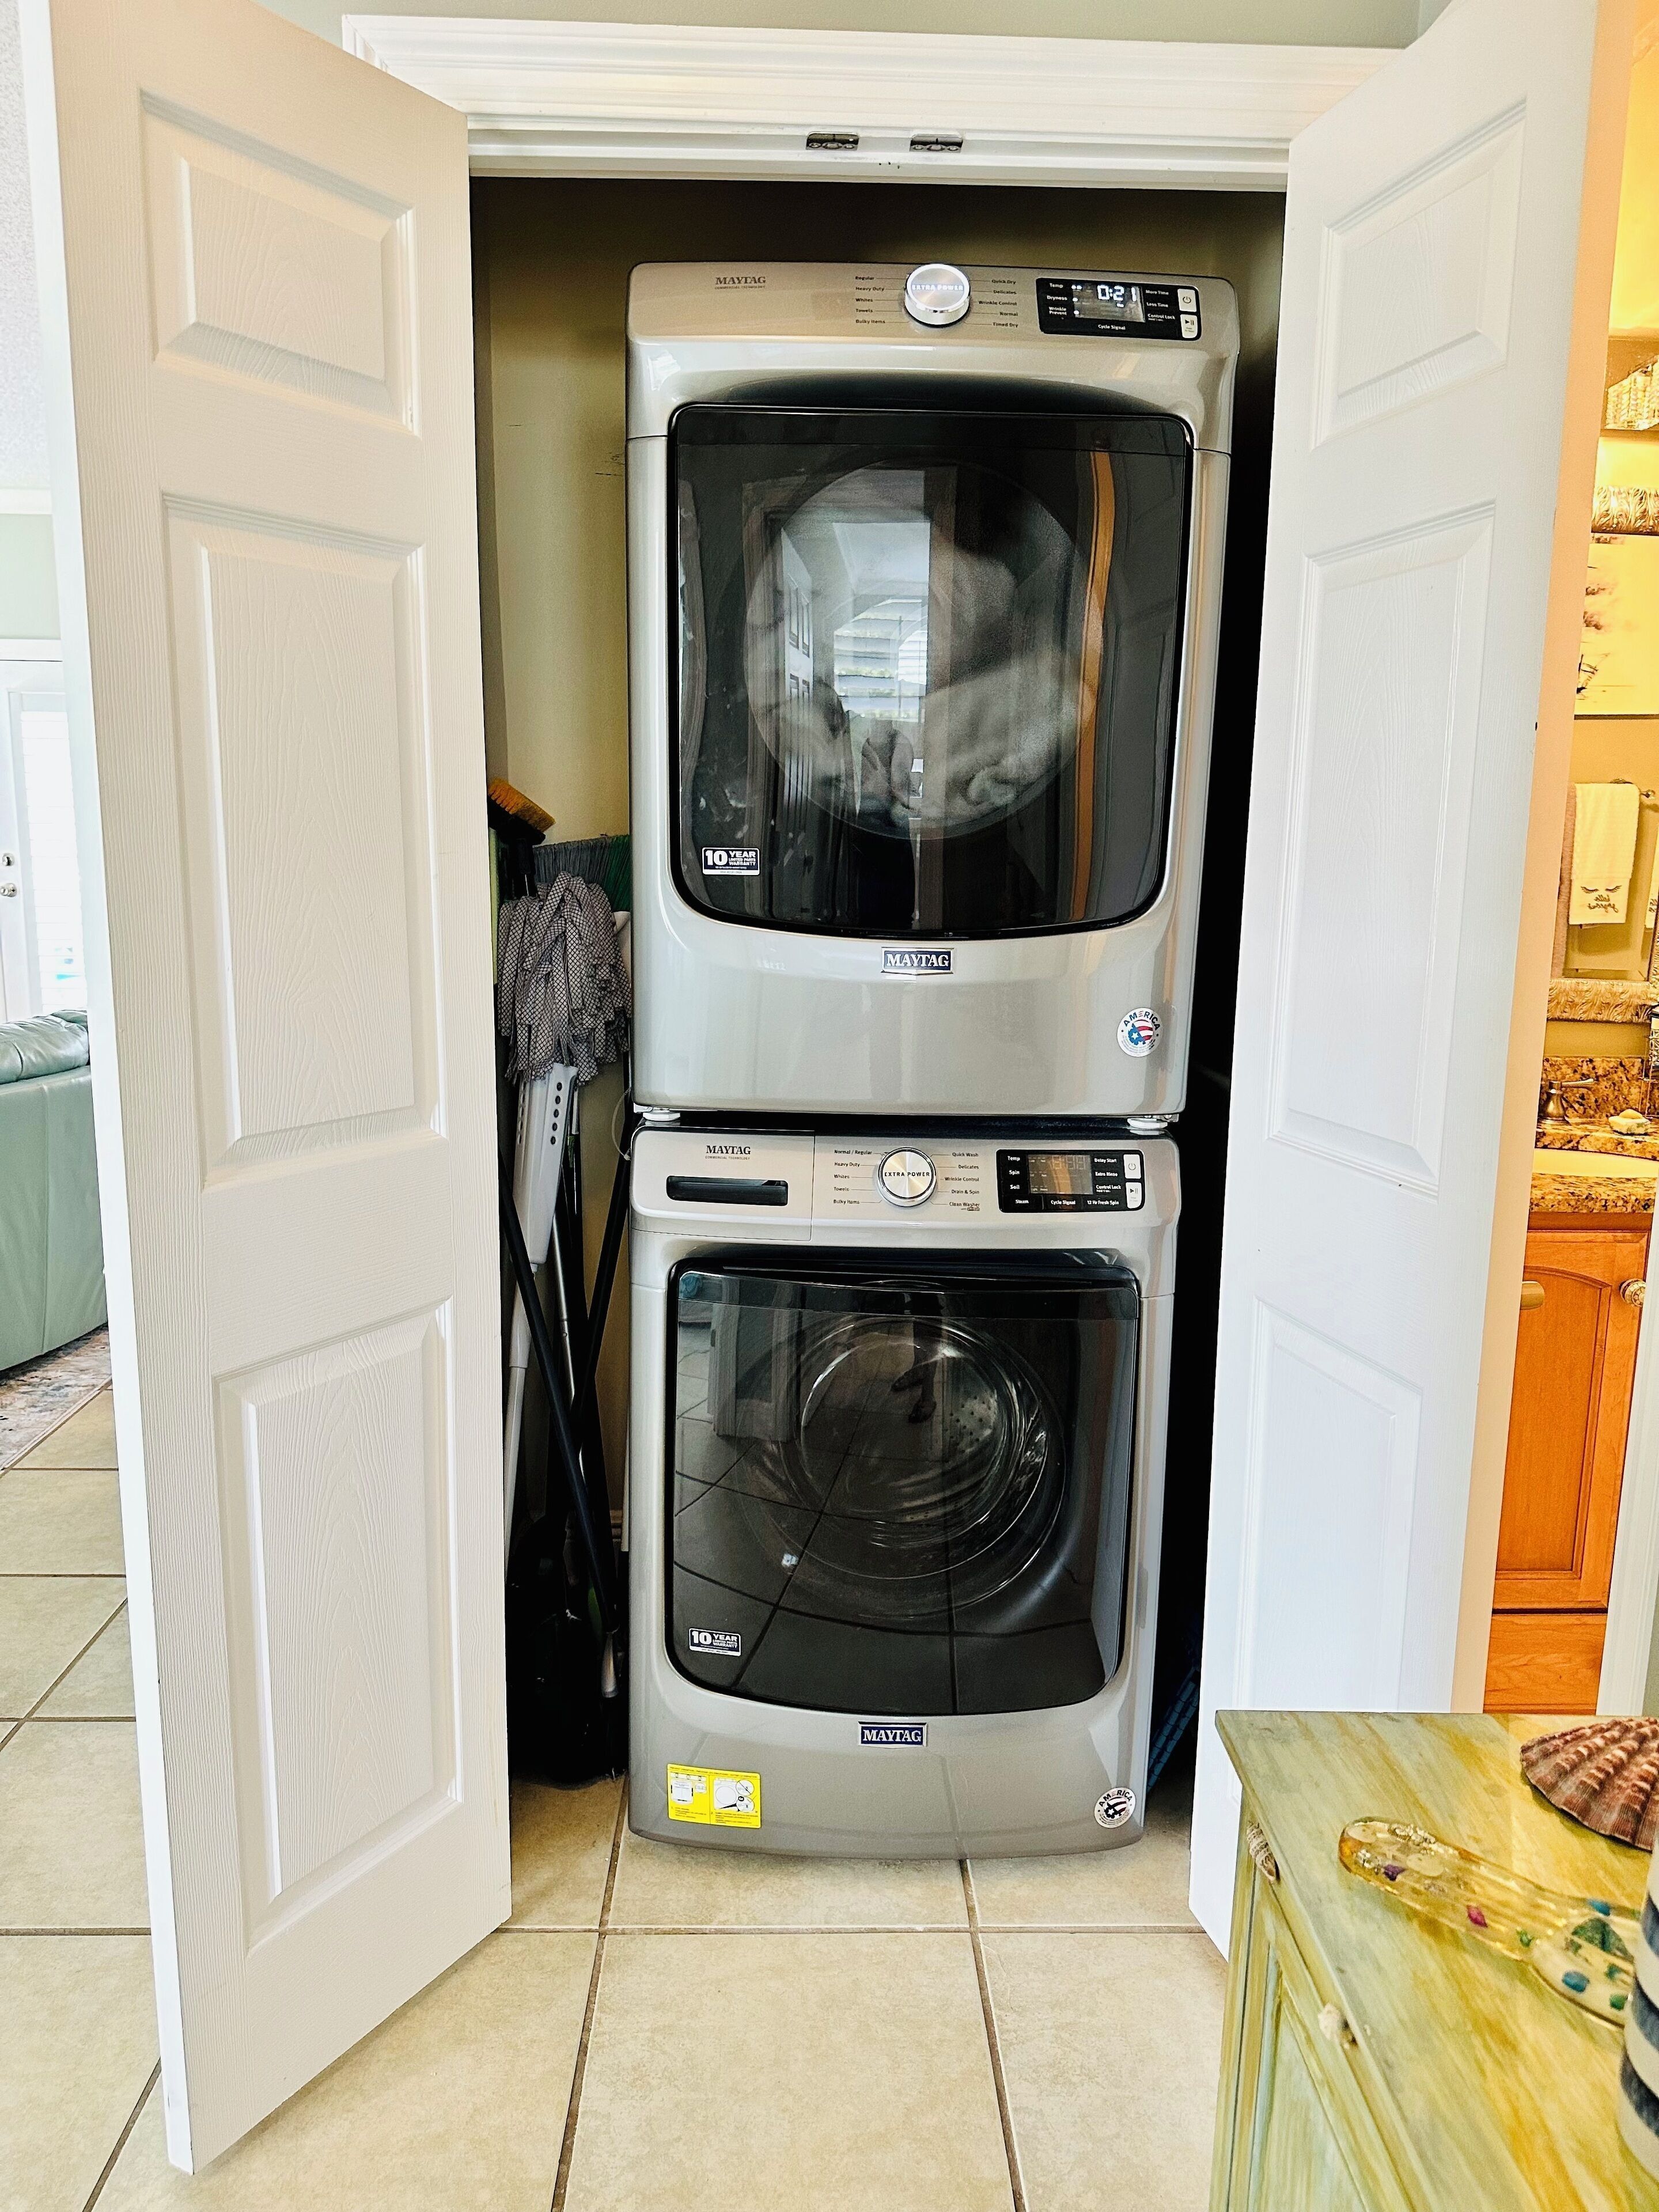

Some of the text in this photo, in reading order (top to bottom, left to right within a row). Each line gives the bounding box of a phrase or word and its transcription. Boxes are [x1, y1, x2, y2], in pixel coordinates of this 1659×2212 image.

[715, 276, 766, 285] MAYTAG
[1097, 285, 1137, 302] 0:21
[705, 850, 728, 866] 10
[886, 953, 949, 967] MAYTAG
[1123, 1010, 1161, 1031] AMERICA
[706, 1145, 751, 1154] MAYTAG
[692, 1631, 738, 1645] 10 YEAR
[862, 1729, 922, 1742] MAYTAG
[1099, 1790, 1132, 1807] AMERICA
